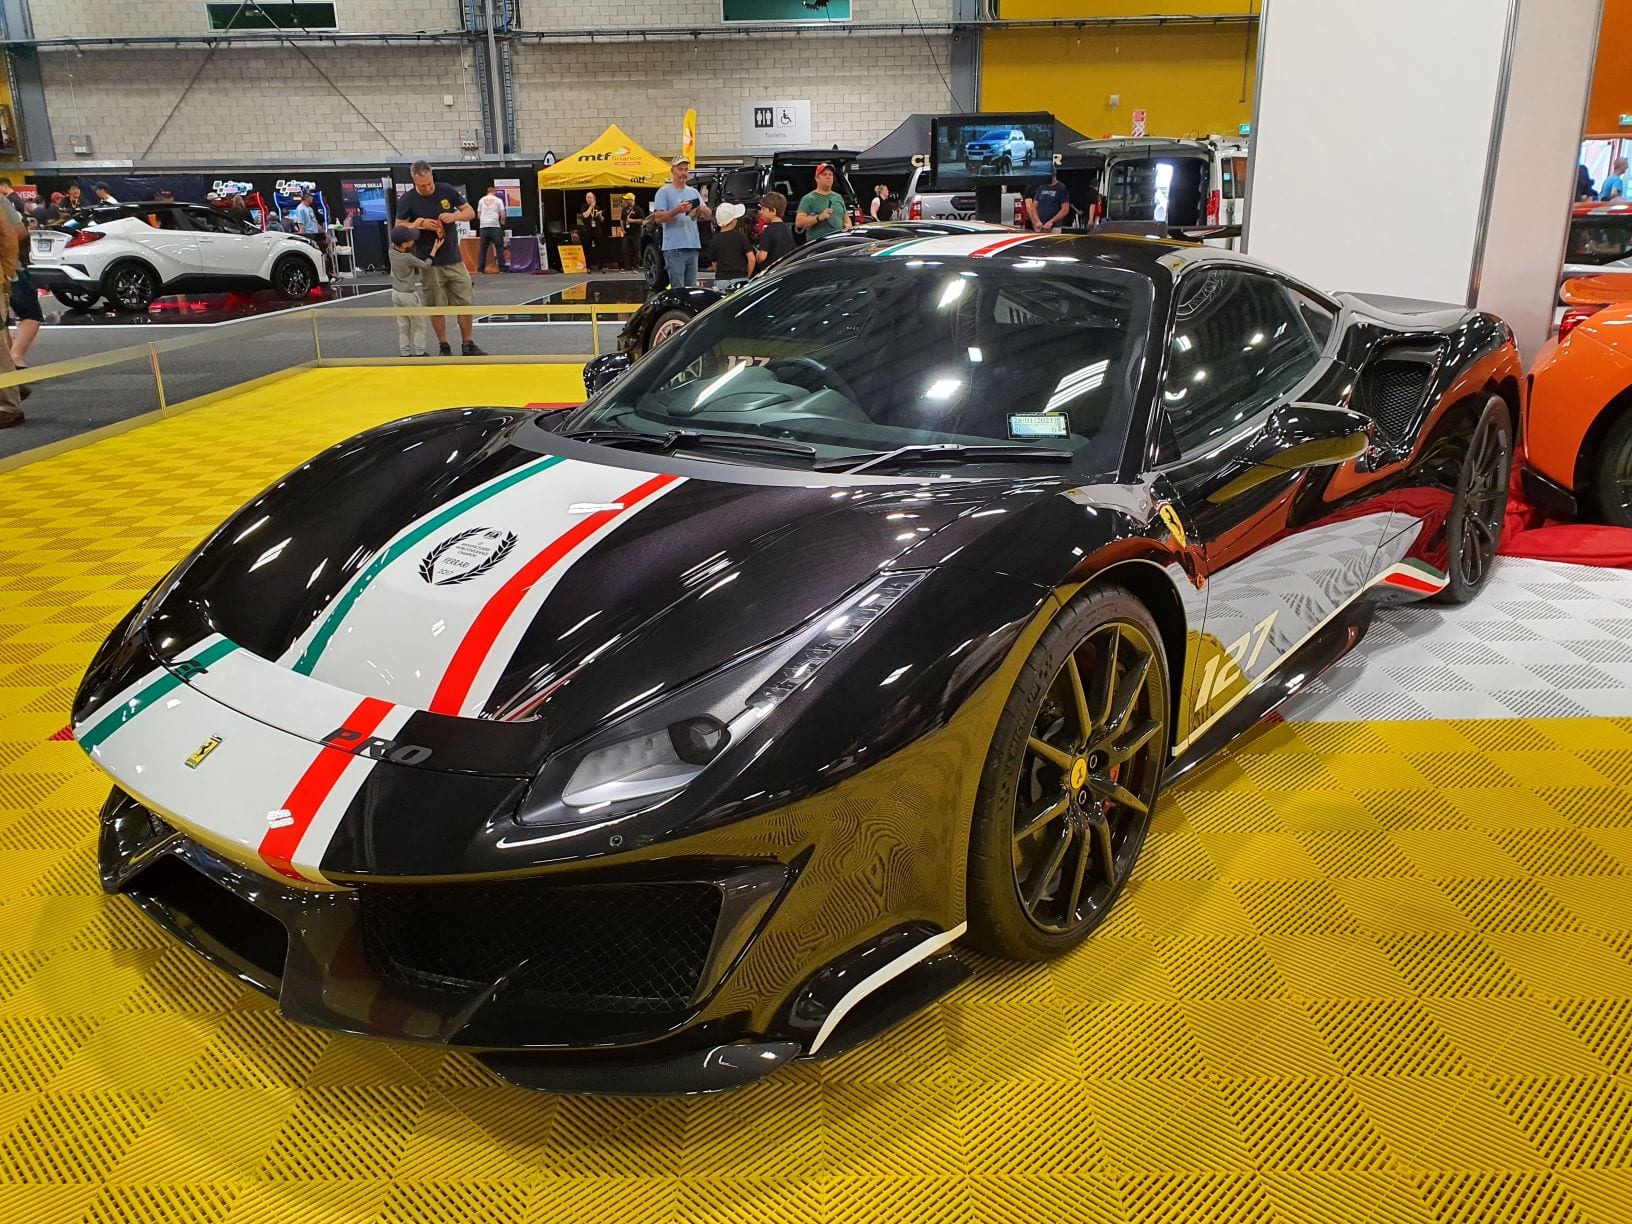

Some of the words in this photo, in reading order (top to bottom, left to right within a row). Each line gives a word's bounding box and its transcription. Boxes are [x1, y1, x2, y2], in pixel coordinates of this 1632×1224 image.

[578, 151, 612, 162] mtf
[442, 556, 471, 569] FERRARI
[437, 568, 454, 576] 2017
[1194, 609, 1279, 713] 127
[320, 727, 432, 765] PRO
